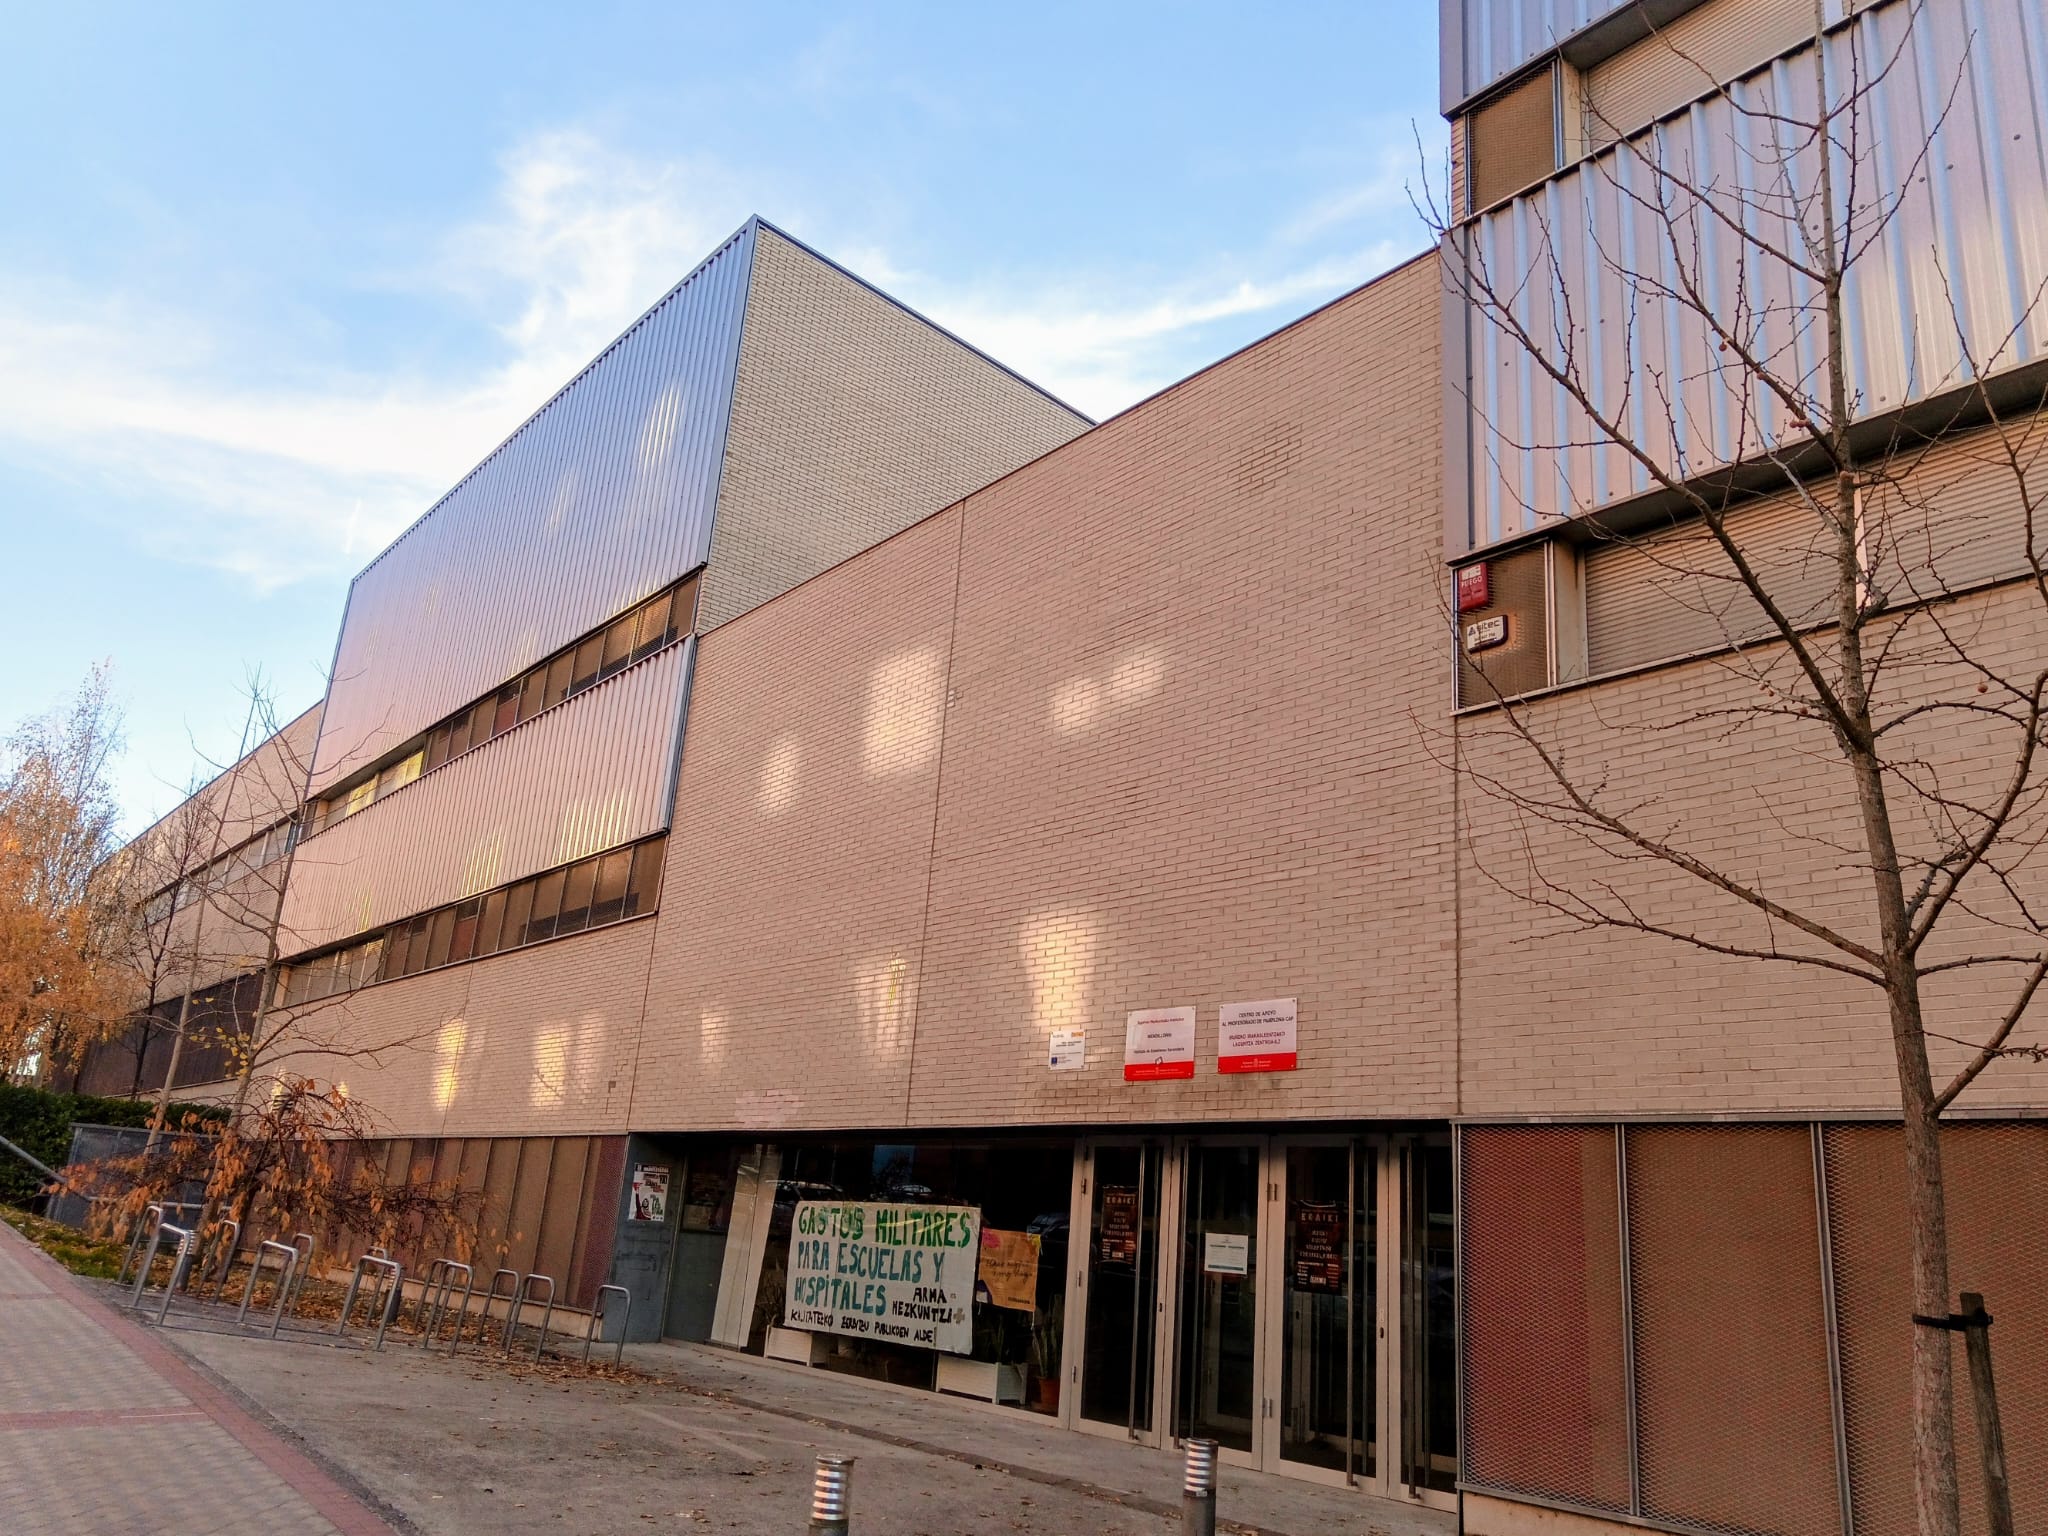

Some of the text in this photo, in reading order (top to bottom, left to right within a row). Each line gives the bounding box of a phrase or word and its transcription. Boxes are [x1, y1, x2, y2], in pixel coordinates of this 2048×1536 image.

[1461, 575, 1483, 588] FUEGO
[798, 1205, 972, 1248] GASTOS MILITARES
[797, 1240, 946, 1283] PARA ESCUELAS Y
[913, 1287, 947, 1304] ARMA
